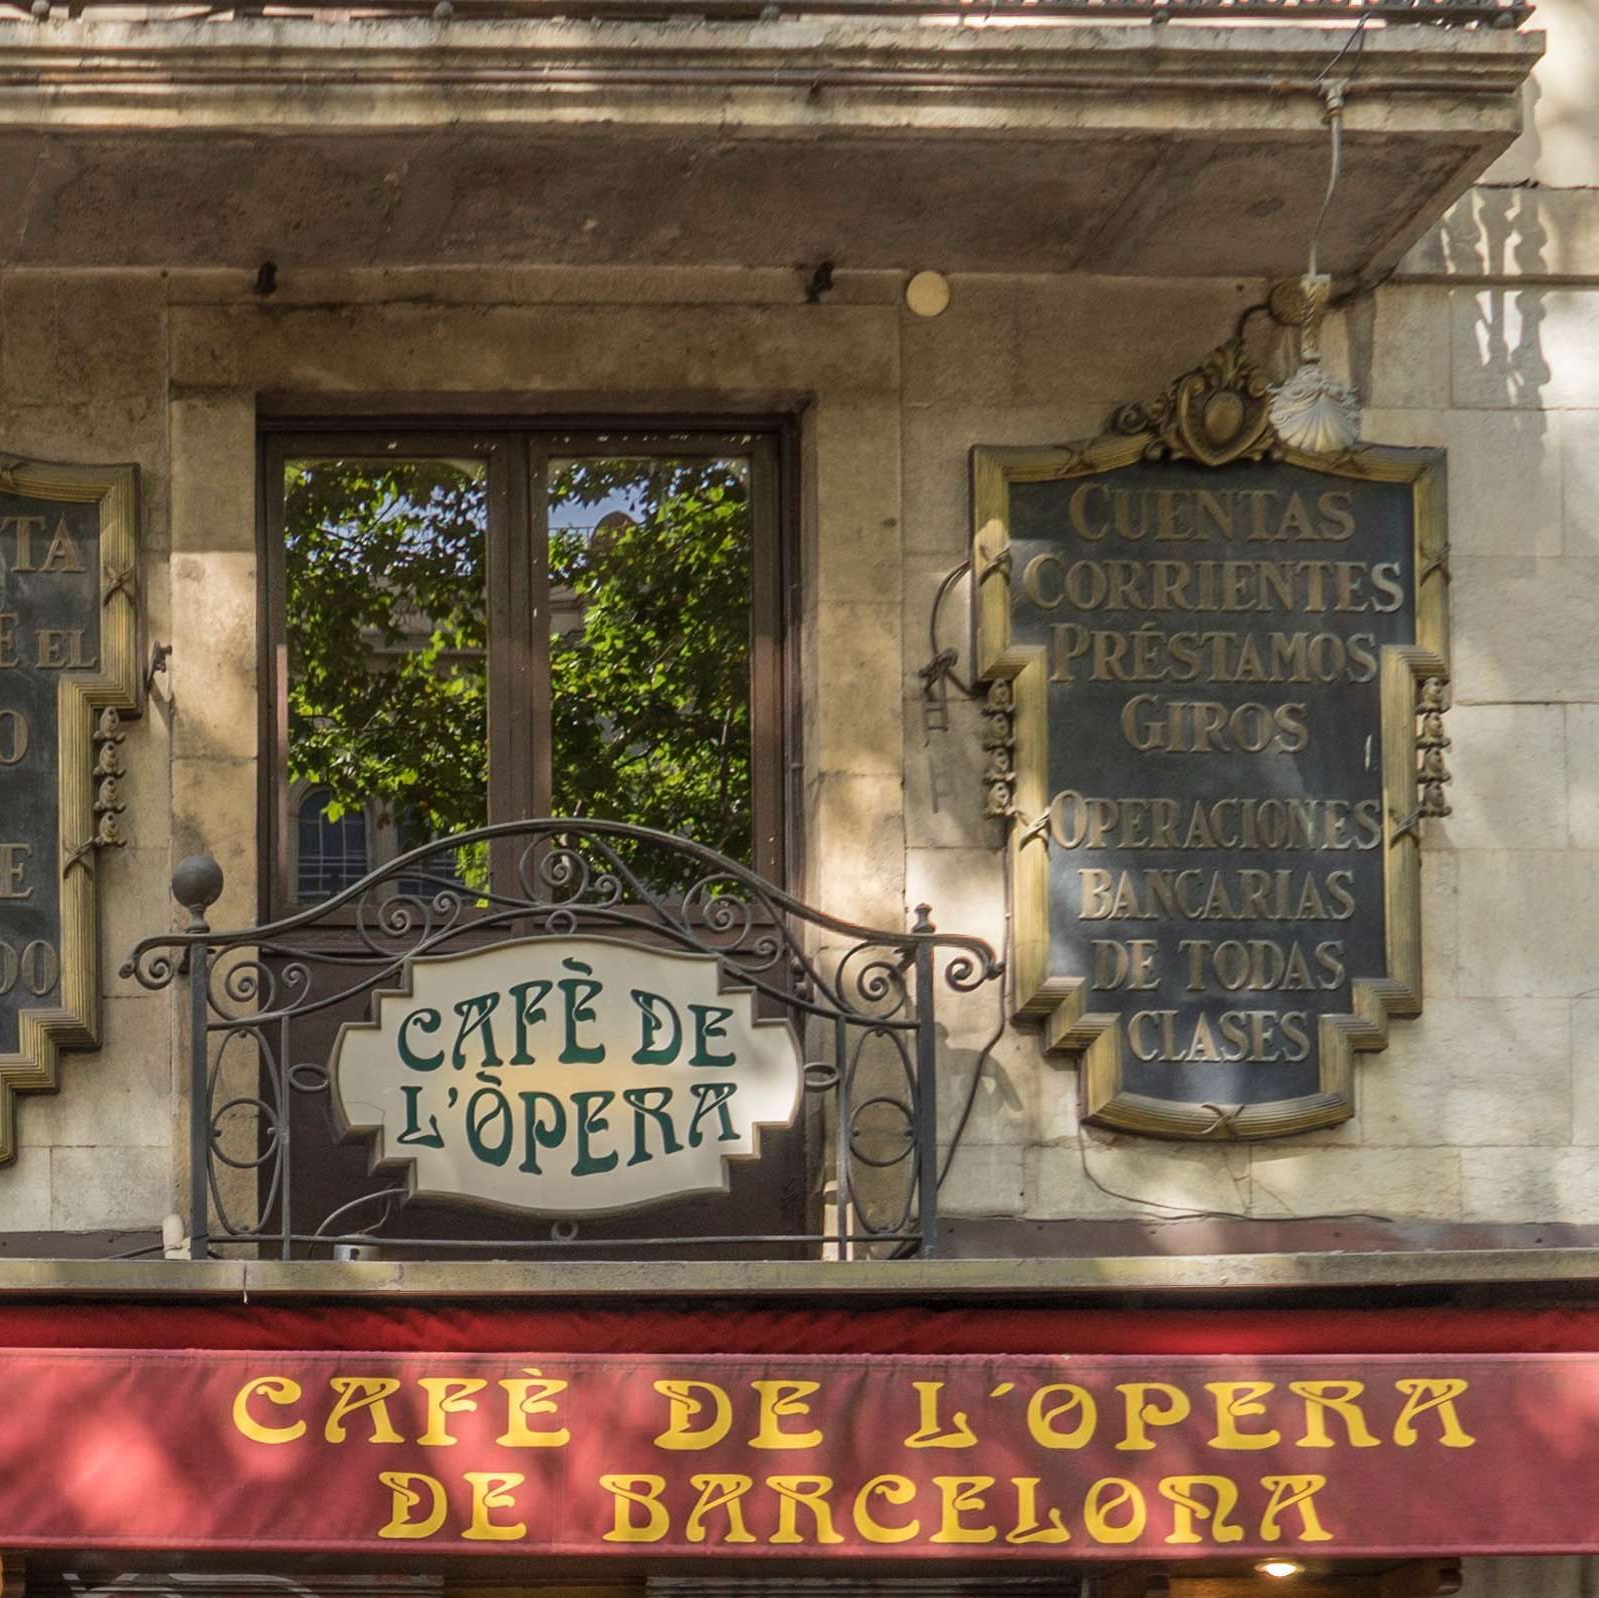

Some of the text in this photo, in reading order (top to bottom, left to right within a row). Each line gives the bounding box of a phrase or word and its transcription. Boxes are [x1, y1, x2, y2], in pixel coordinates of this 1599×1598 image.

[1070, 483, 1356, 543] CUENTAS
[1022, 553, 1404, 614] CORRIENTES
[37, 627, 97, 670] EL
[1051, 621, 1379, 684] PRÉSTAMOS
[1123, 694, 1310, 754] GIROS
[1051, 790, 1382, 853] OPERACIONES
[1079, 868, 1356, 922] BANCARIAS
[1092, 938, 1345, 992] DE TODAS
[397, 956, 737, 1072] CAFÈ DE
[1127, 1010, 1312, 1064] CLASES
[653, 1379, 825, 1451] DE
[376, 1471, 1335, 1545] DE BARCELONA
